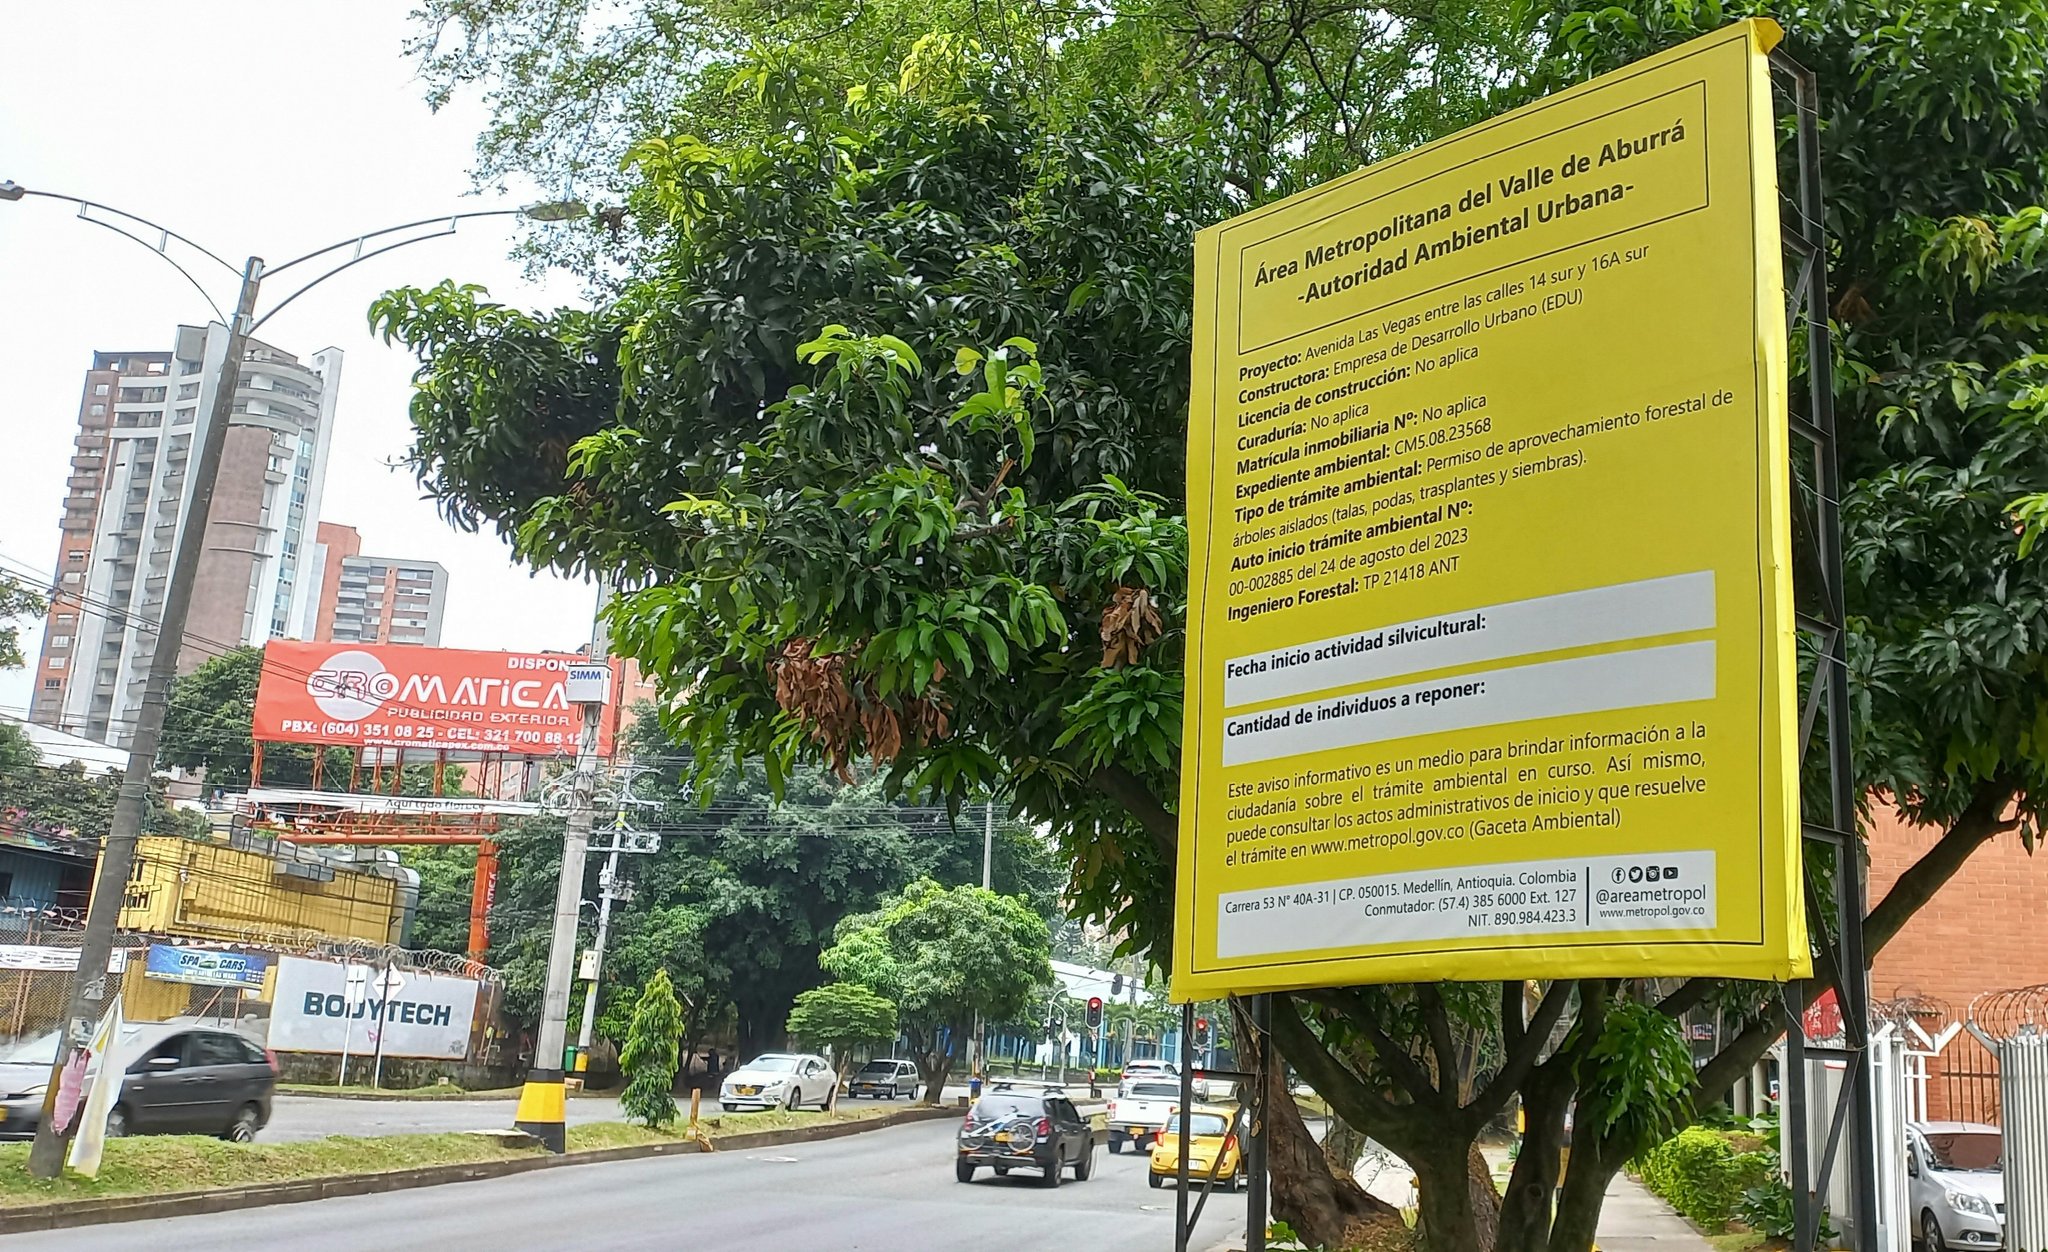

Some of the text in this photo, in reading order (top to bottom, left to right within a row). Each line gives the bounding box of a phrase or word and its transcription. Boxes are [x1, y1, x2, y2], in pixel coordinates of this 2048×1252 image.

[1253, 117, 1686, 288] Área Metropolitana del Valle Aburrá
[1297, 183, 1635, 305] -Autoridad Ambiental Urbana-
[1238, 245, 1650, 383] Proyecto: Avenida Las Vegas entre las calles 14 sur 16A sur
[1238, 287, 1583, 405] Constructora: Empresa Desarrollo Urbano (EDU)
[1237, 346, 1479, 429] Licencia construcción: No aplica
[1233, 388, 1734, 525] Tipo trámite ambiental: Permiso aprovechamiento forestal de
[1235, 416, 1492, 501] Expediente ambiental: CM5.08.23568
[1236, 403, 1370, 452] Curaduría: No aplica
[1236, 395, 1487, 476] Matrícula inmobiliaria No aplica
[1232, 448, 1587, 549] árboles aislados (talas, podas, trasplantes siembras).
[1228, 527, 1469, 597] 00-002885 del 24 de agosto del 2023
[1230, 504, 1443, 573] Auto inicio trámite ambiental
[1227, 554, 1461, 623] Ingeniero Forestal: TP 21418 ANT
[507, 657, 587, 672] DISPON
[569, 669, 602, 681] SIMM
[1227, 612, 1487, 680] Fecha inicio actividad silvicultural:
[281, 719, 318, 733] PBX:
[321, 721, 360, 738] (604)
[363, 724, 390, 737] 351
[394, 725, 413, 738] 08
[416, 726, 434, 739] 25
[446, 727, 480, 741] CEL:
[483, 729, 510, 743] 321
[514, 730, 542, 744] 700
[544, 732, 563, 745] 88
[387, 707, 571, 727] PUBLICIDAD EXTERIOR
[1226, 680, 1486, 738] Cantidad de individuos reponer:
[1226, 750, 1706, 822] ciudadanía sobre el trámite ambiental en curso. Así mismo,
[1228, 720, 1706, 799] Este aviso informativo es un medio para brindar información la
[1225, 807, 1621, 867] el trámite en www.metropol.gov.co (Gaceta Ambiental)
[1226, 774, 1707, 849] puede consultar los actos administrativos de inicio que resuelve
[1224, 868, 1577, 915] Carrera 53 40A-31 CP. 050015. Medellín, Antioquia. Colombia
[1363, 887, 1577, 918] Conmutador: (57.4) 385 6000 Ext. 127
[1467, 907, 1577, 928] NIT. 890.984.423.3
[1595, 883, 1707, 906] @areametropol
[1599, 904, 1706, 919] www.metropol.gov.co
[180, 954, 246, 971] SPA CARS
